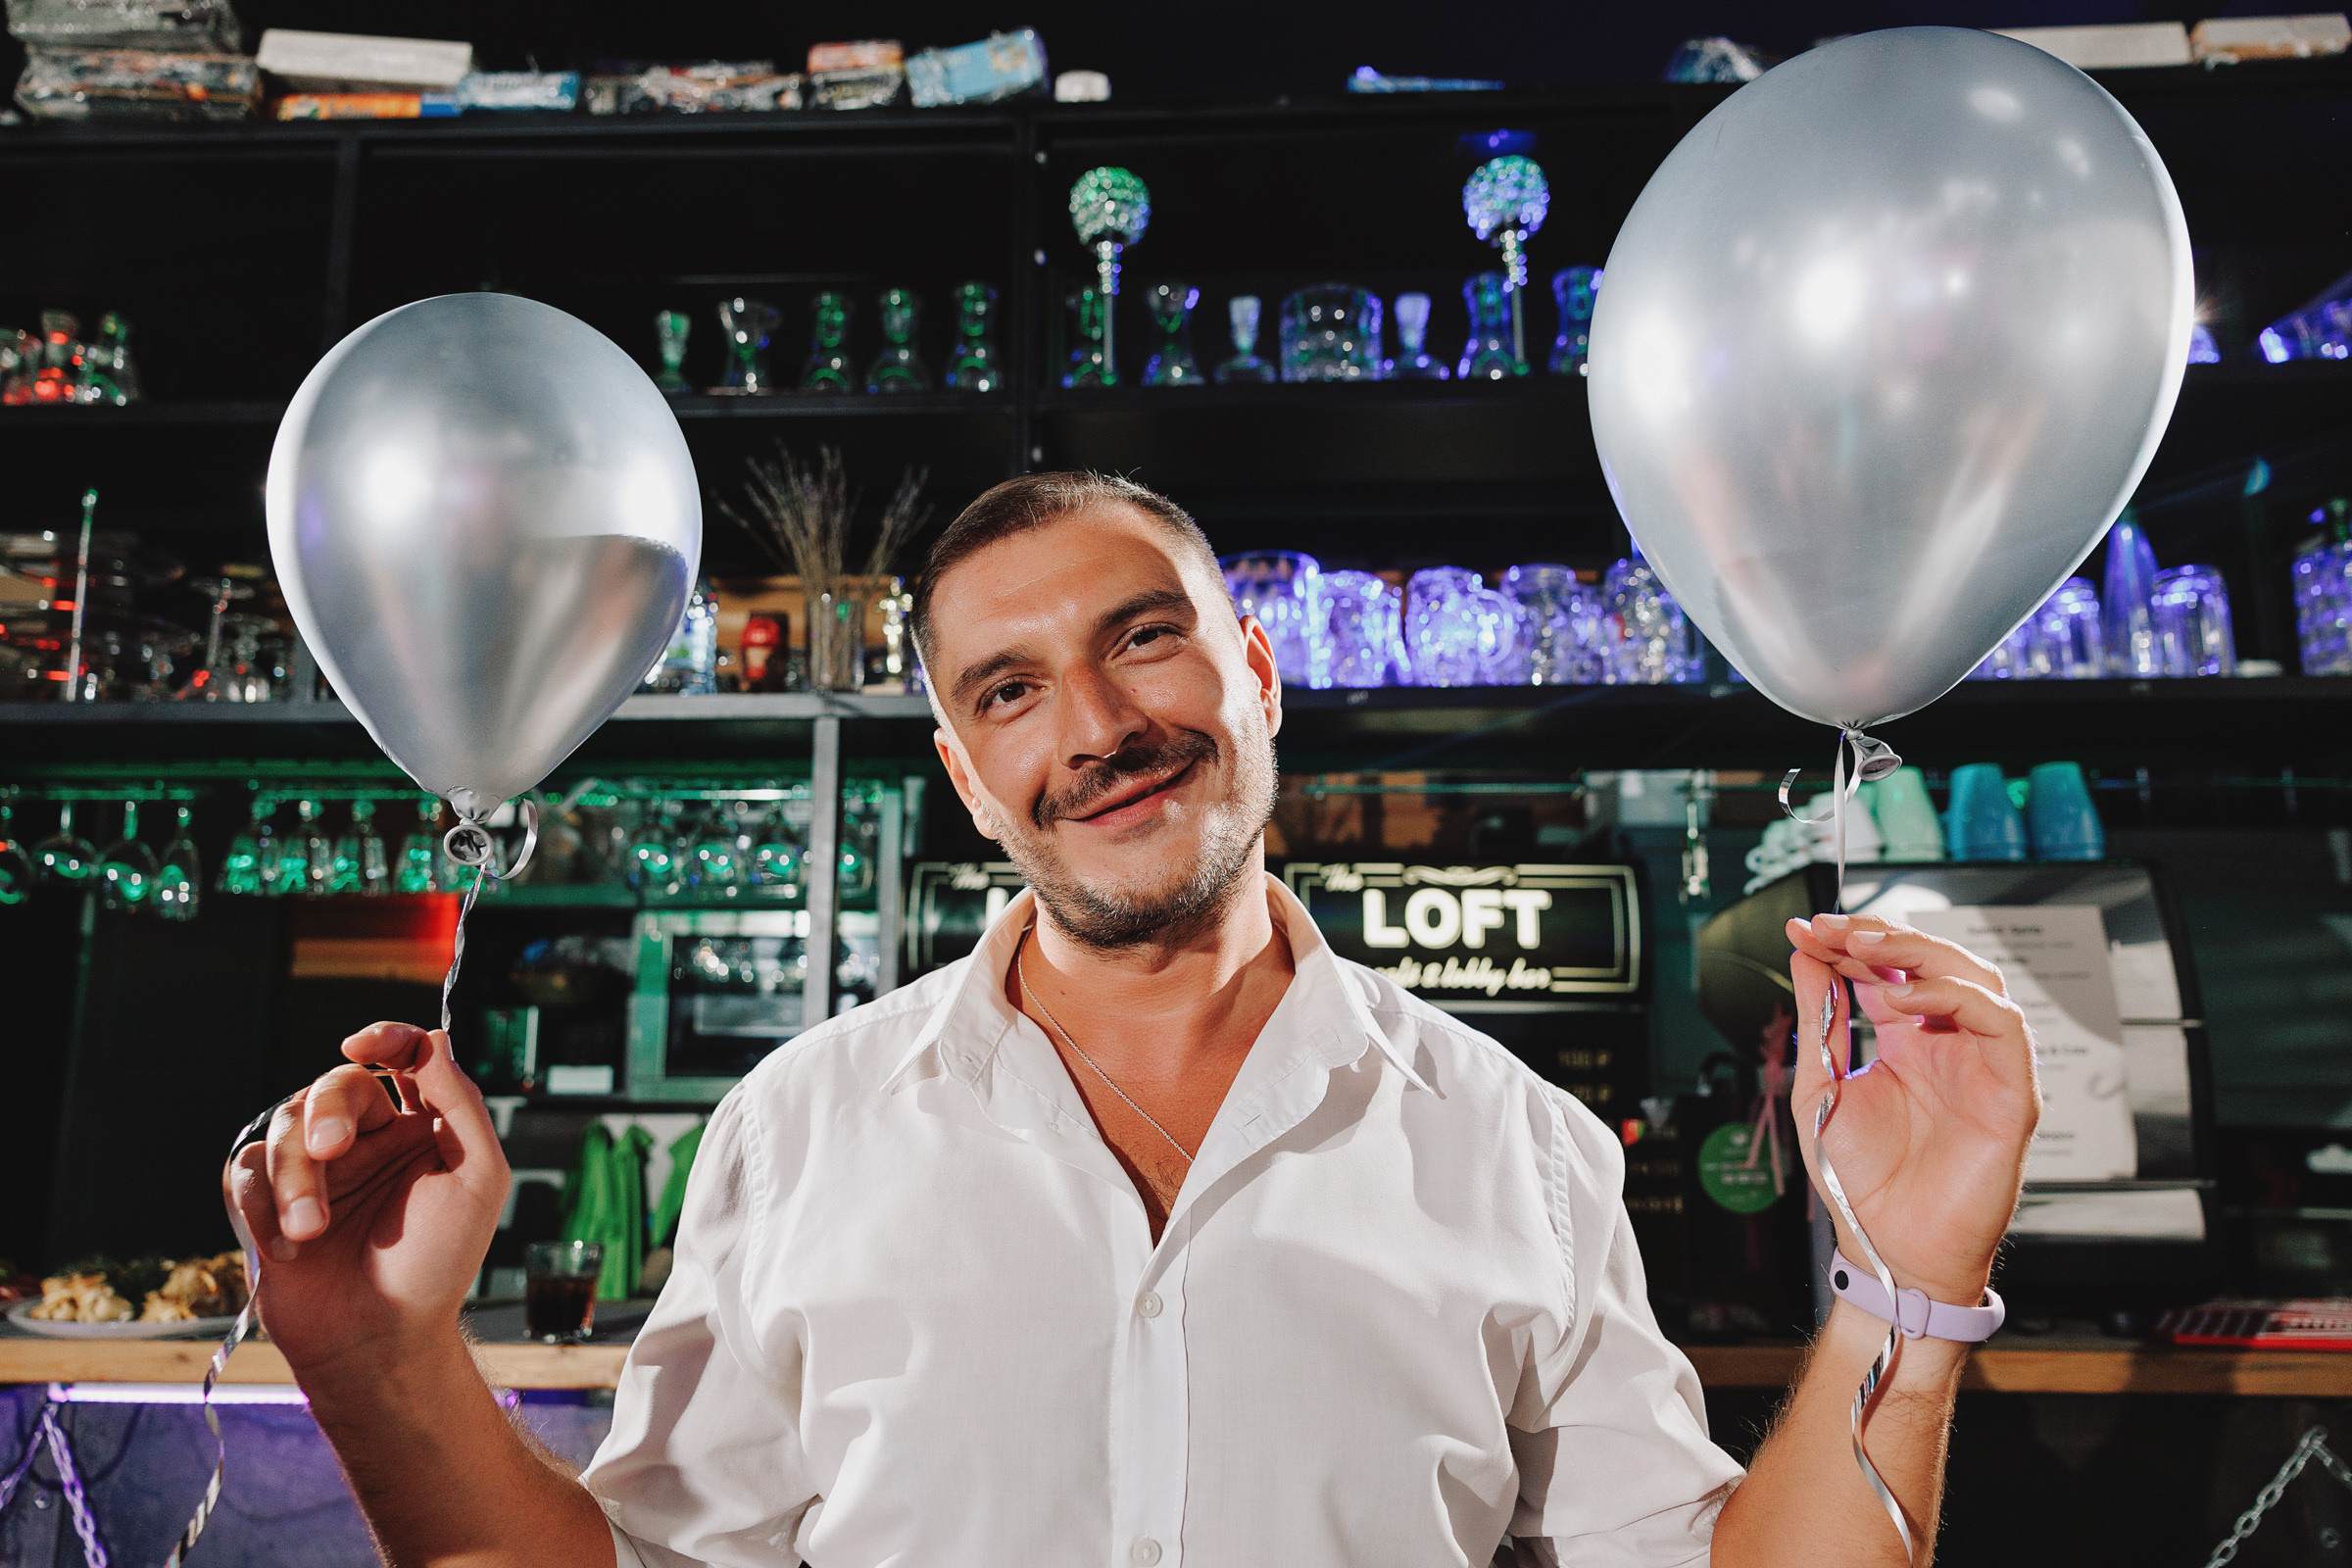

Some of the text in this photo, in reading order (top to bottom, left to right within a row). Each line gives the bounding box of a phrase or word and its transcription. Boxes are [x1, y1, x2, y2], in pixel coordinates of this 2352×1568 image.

[1362, 888, 1552, 950] LOFT
[1441, 956, 1505, 997] lobby
[1506, 956, 1552, 990] bar
